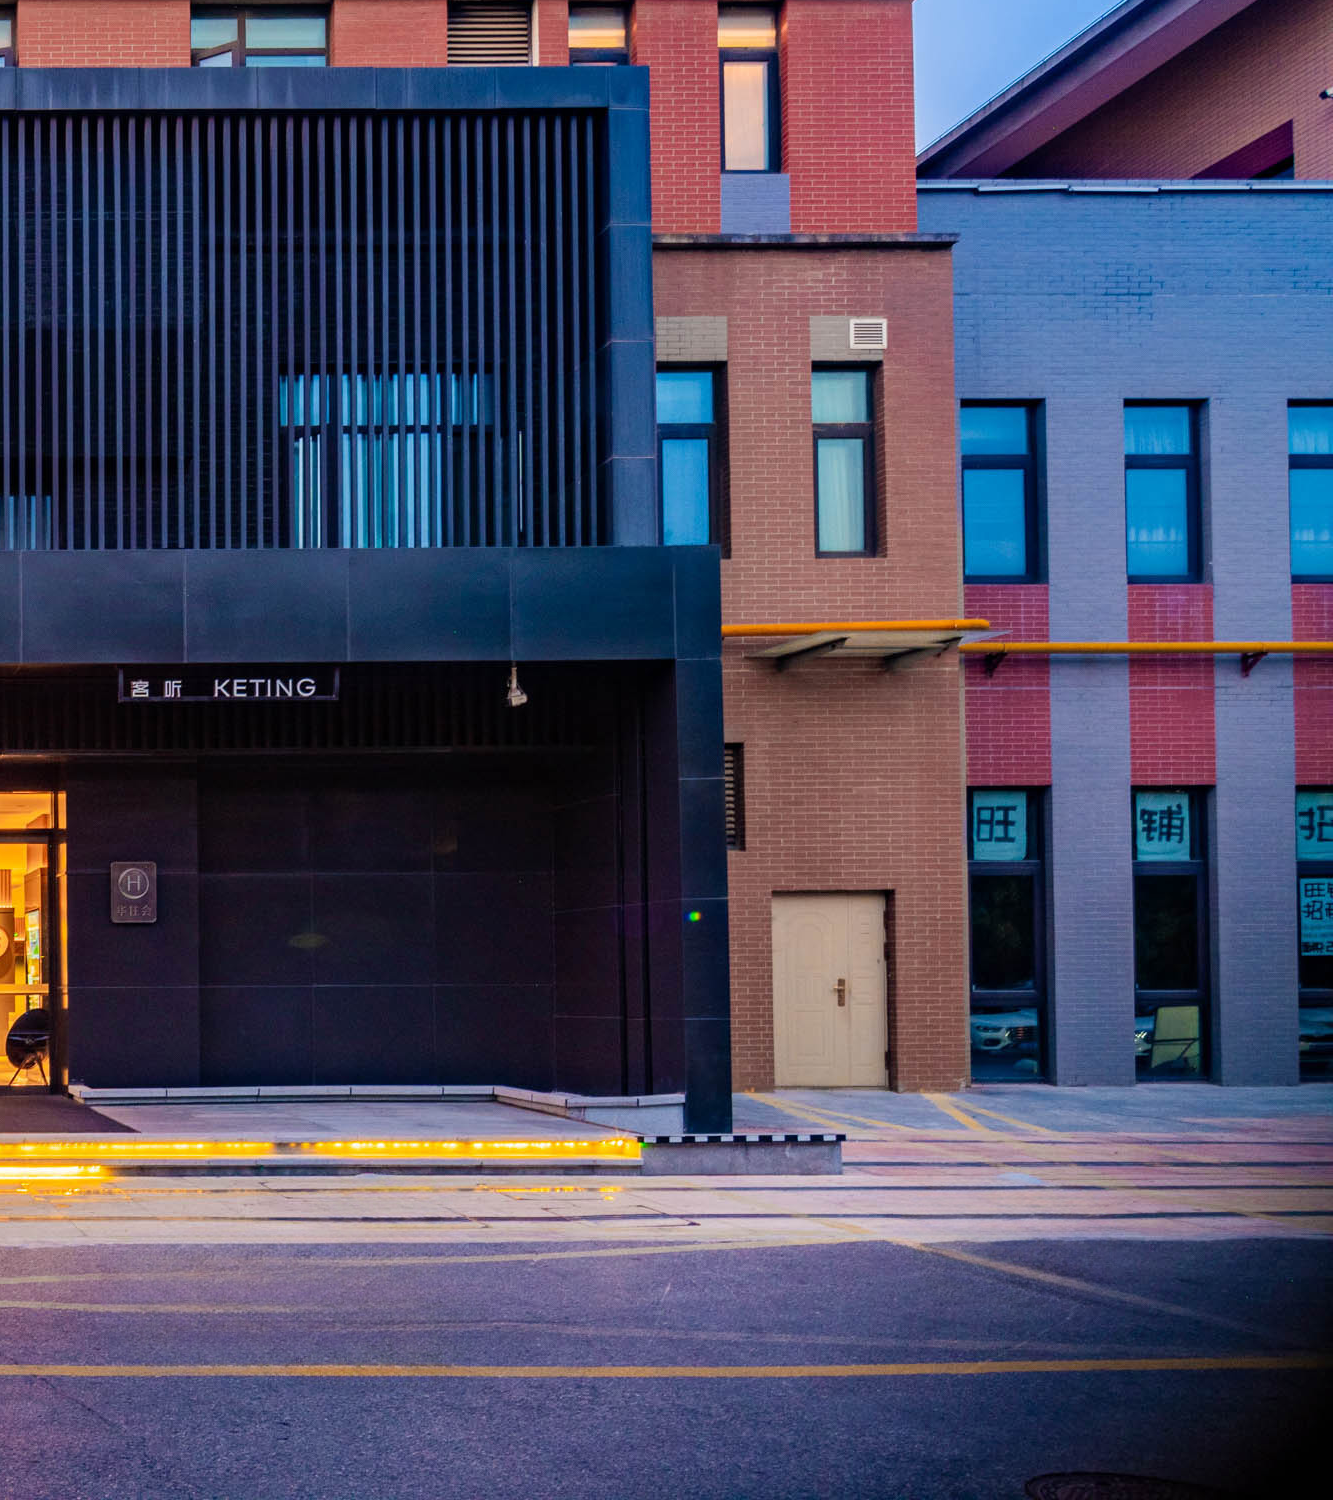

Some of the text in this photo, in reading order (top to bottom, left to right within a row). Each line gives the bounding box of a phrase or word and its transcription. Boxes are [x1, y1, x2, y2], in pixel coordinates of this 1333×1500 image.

[214, 678, 316, 698] KETING
[976, 805, 1018, 843] 旺
[1140, 803, 1186, 844] 铺
[1304, 882, 1333, 898] 旺
